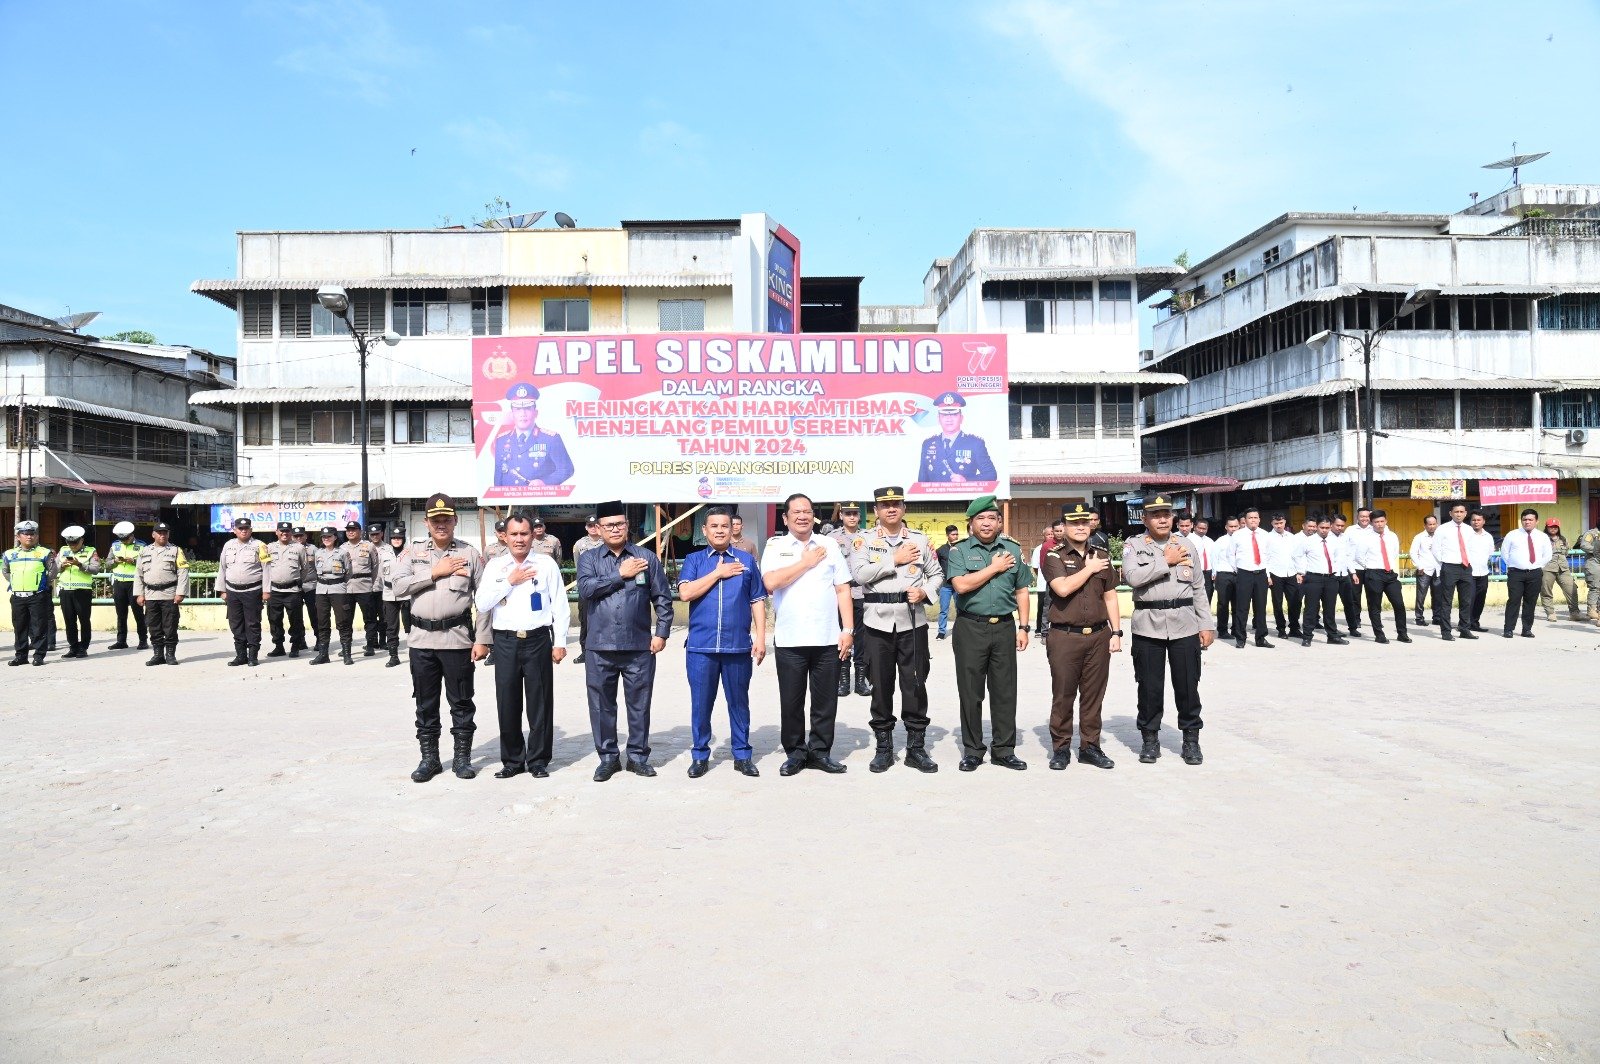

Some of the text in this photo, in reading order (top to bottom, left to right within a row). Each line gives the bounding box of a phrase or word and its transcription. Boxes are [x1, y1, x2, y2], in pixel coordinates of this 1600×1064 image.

[768, 269, 793, 300] KING
[532, 338, 944, 376] APEL SISKAMLING
[661, 379, 825, 396] DALAM RANGKA
[565, 399, 918, 418] MENINGKATKAN HARKAMTIBMAS
[577, 418, 906, 437] MENJELANG PEMILU SERENTAK
[677, 437, 807, 455] TAHUN 2024
[629, 460, 854, 475] POLRES PADANGSIDIMPUAN
[716, 485, 782, 495] PRESISI
[1482, 485, 1497, 497] TOKO
[1520, 485, 1552, 494] Bata
[276, 502, 306, 510] TOKO
[278, 512, 301, 521] IBU
[305, 511, 337, 521] AZIS
